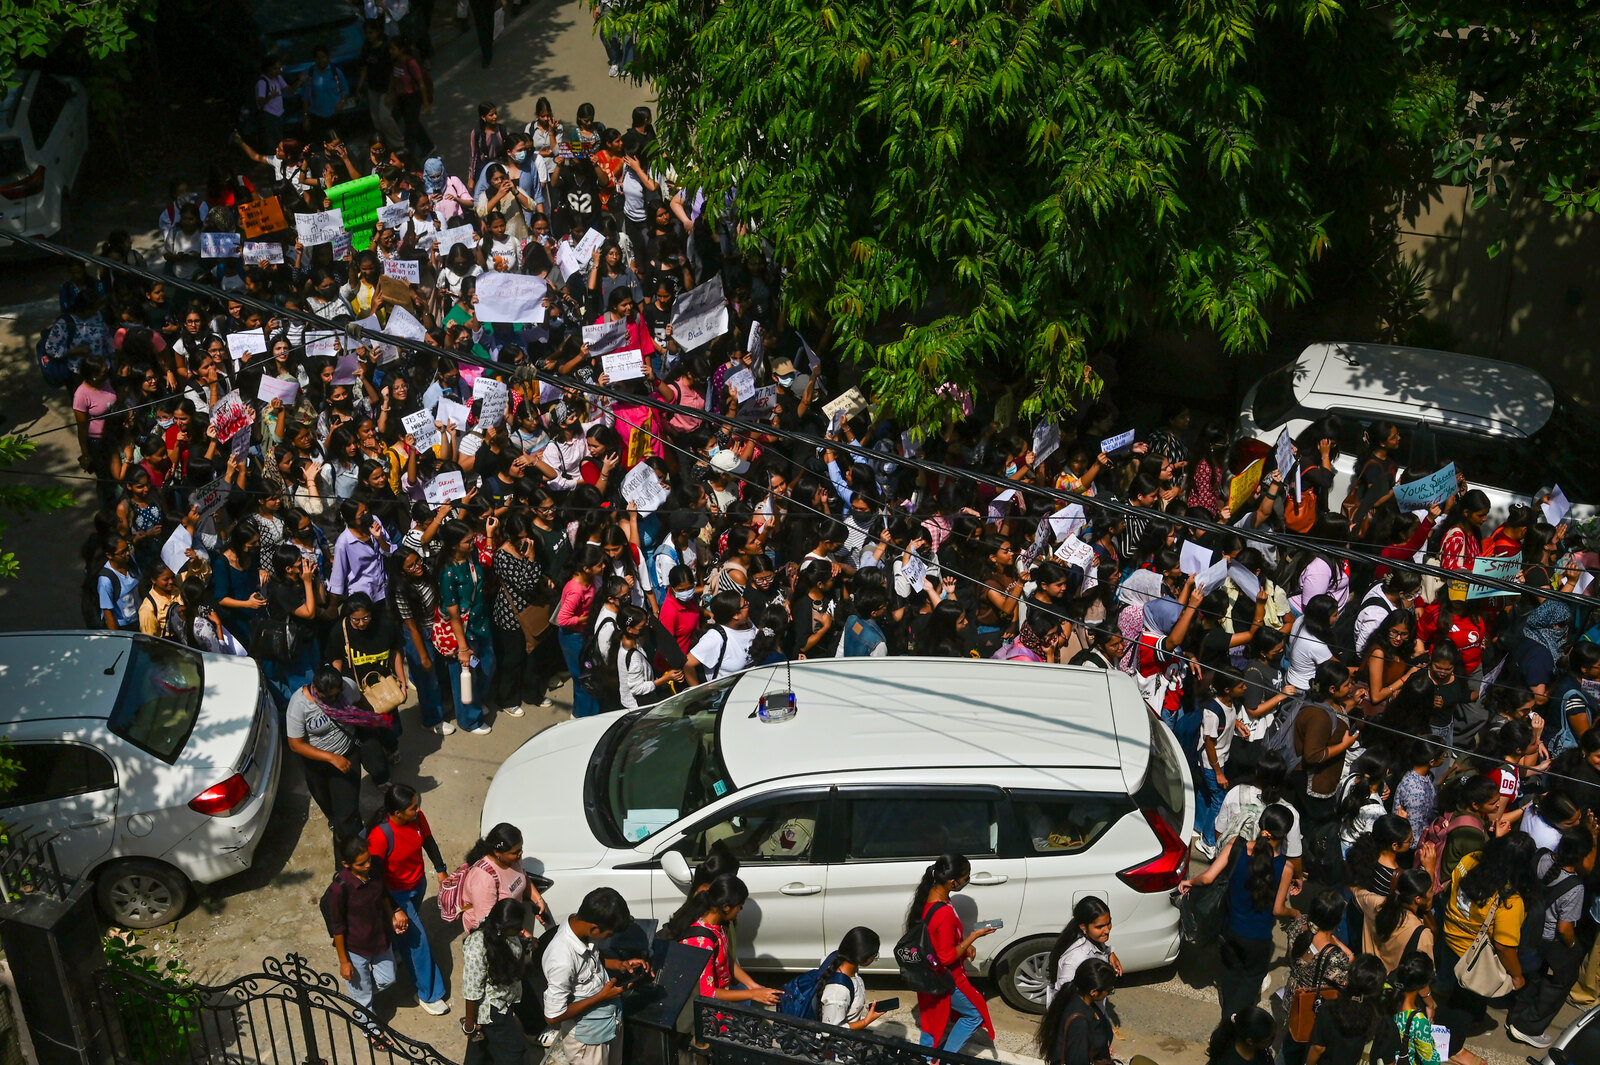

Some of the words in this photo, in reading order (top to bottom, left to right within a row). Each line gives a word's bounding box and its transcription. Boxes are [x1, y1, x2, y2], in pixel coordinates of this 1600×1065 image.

[203, 490, 217, 505] NOT
[1401, 483, 1429, 499] YOUR
[1485, 559, 1520, 572] SMASH
